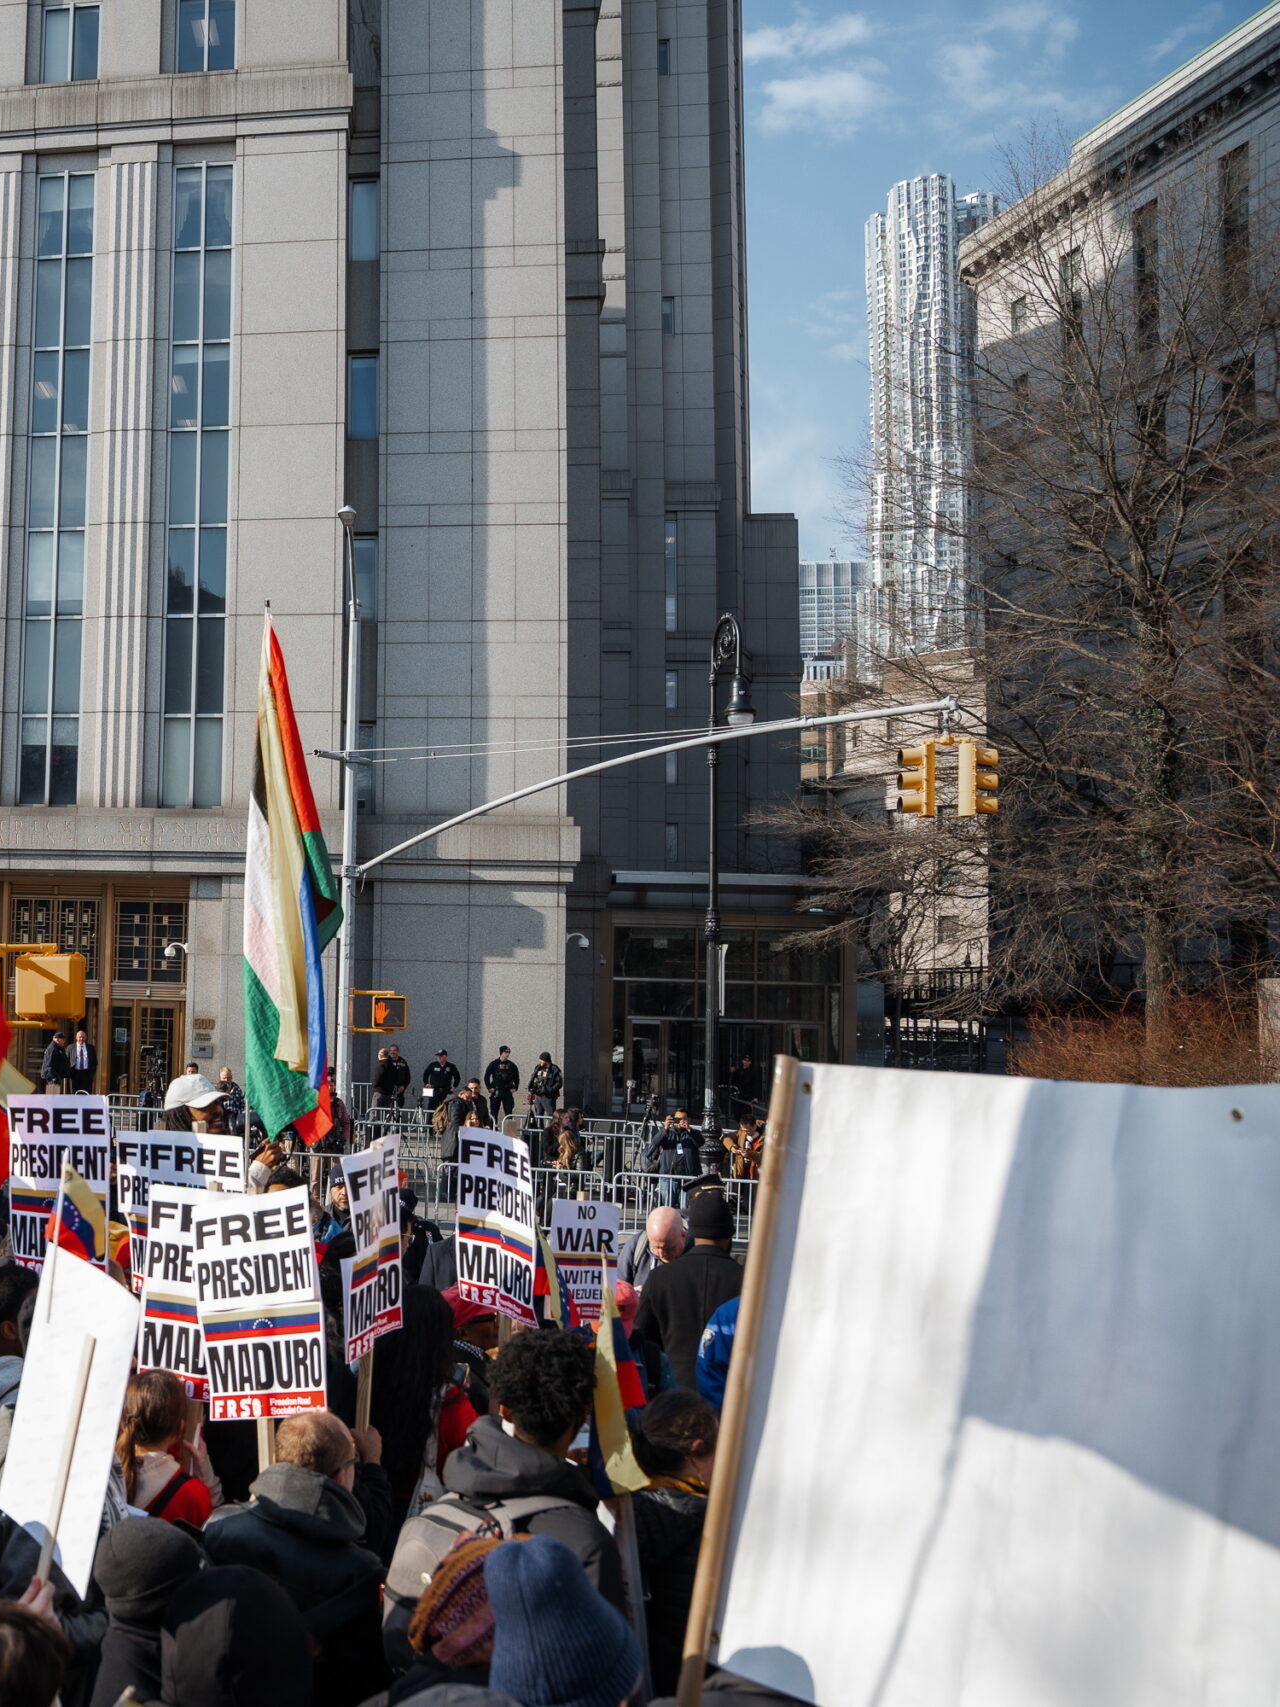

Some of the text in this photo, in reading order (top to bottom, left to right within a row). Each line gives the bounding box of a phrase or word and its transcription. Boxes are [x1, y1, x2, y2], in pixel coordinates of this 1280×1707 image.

[181, 835, 241, 848] HOUS
[10, 1107, 106, 1135] FREE
[11, 1143, 108, 1181] PRESIDENT
[150, 1142, 241, 1179] FREE
[460, 1138, 531, 1184] FREE
[460, 1173, 533, 1229] PRESIDENT
[577, 1205, 596, 1220] NO
[11, 1213, 49, 1258] MAD
[195, 1202, 309, 1251] FREE
[556, 1226, 615, 1254] WAR
[197, 1246, 312, 1302] PRESIDENT
[564, 1269, 602, 1285] WITH
[349, 1262, 400, 1338] MARO
[141, 1321, 207, 1376] MAD
[207, 1336, 323, 1394] MADURO
